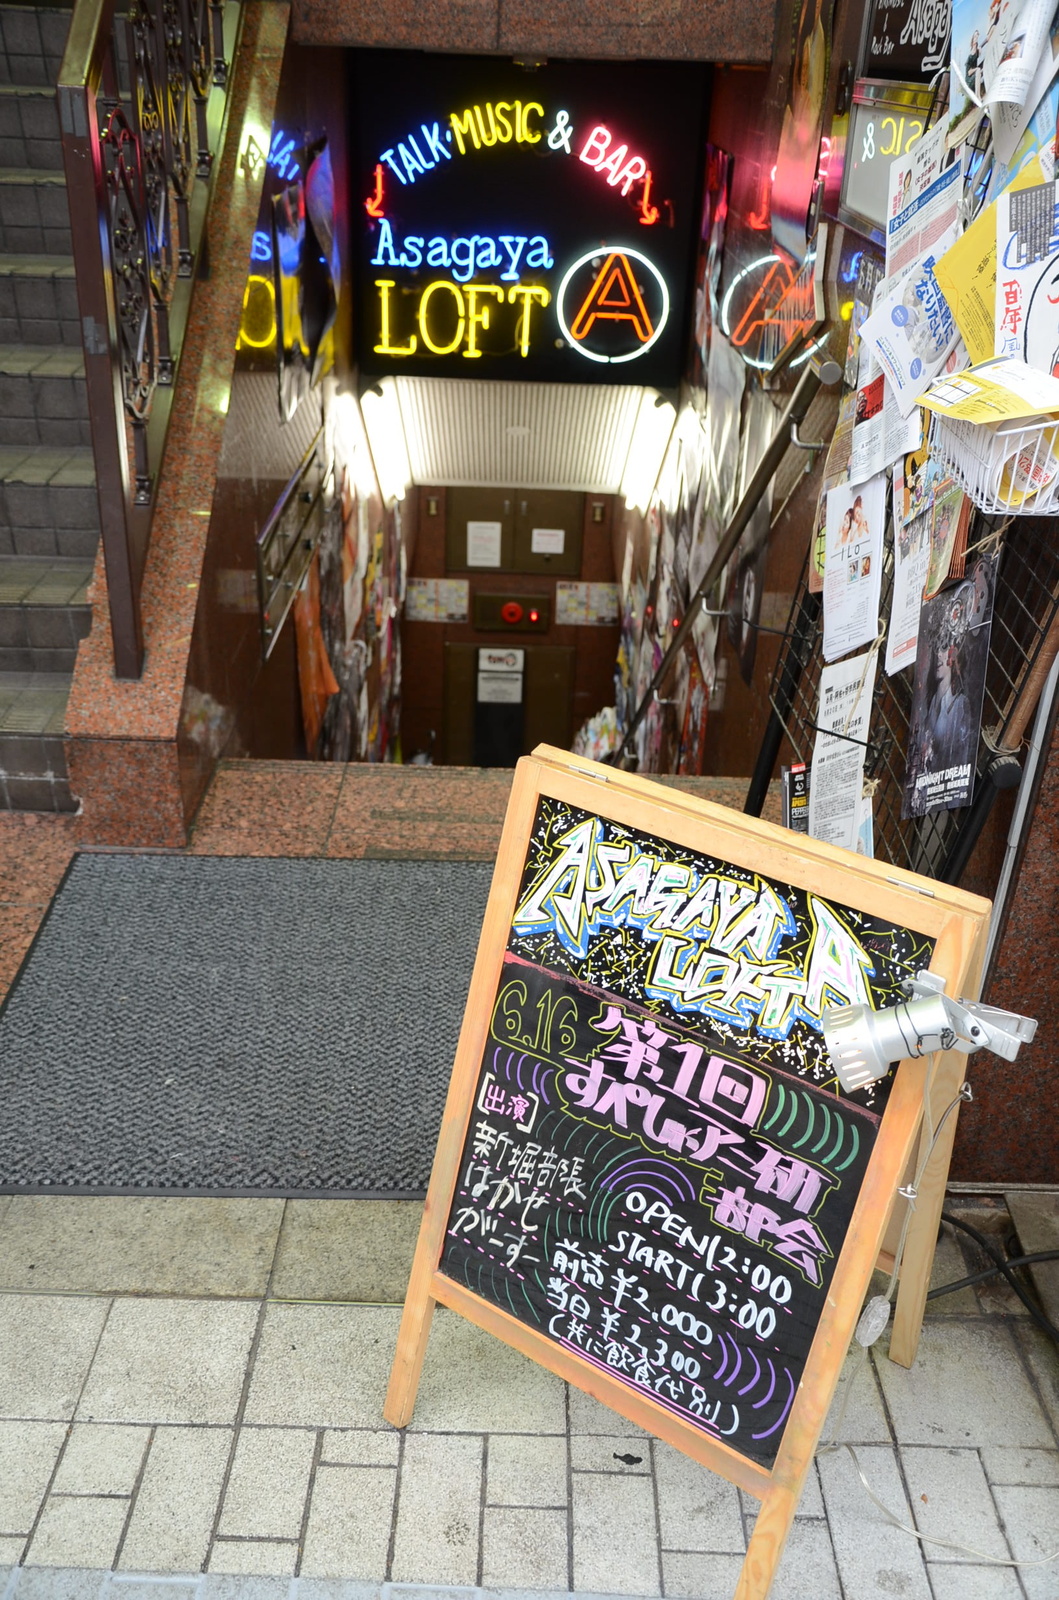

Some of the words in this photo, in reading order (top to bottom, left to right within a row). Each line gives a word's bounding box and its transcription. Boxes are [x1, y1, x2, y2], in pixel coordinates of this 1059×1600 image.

[450, 100, 545, 155] MUSIC
[547, 109, 574, 154] &
[579, 126, 647, 197] BAR
[371, 218, 554, 282] Asagaya
[373, 280, 550, 358] LOFT
[569, 250, 655, 343] A
[915, 768, 945, 790] MIDNIGHT
[944, 763, 971, 781] DREAM
[594, 1006, 766, 1127] 第1回
[464, 1162, 550, 1232] はかせ
[473, 1120, 587, 1200] 新堀部長
[625, 1191, 709, 1257] OPEN
[705, 1235, 793, 1304] 12:00
[706, 1186, 828, 1285] 部会
[546, 1277, 591, 1320] 当日
[608, 1231, 695, 1290] START
[690, 1273, 777, 1339] 13:00
